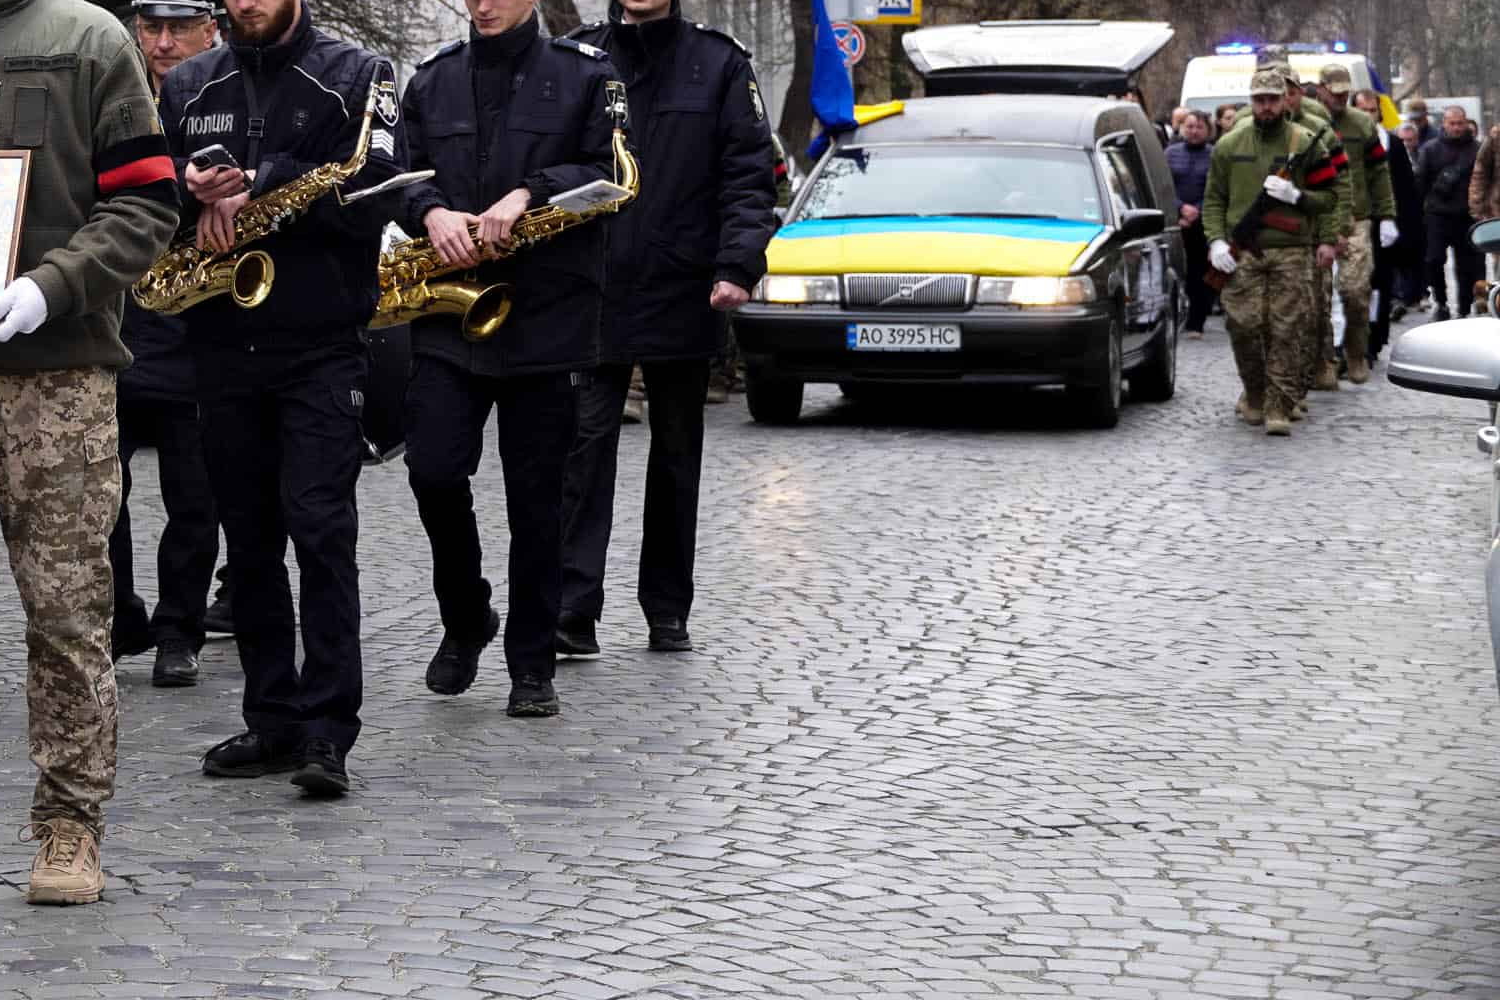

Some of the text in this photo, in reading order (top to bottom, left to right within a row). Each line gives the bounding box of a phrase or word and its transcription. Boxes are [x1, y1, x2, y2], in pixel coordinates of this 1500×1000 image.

[860, 327, 955, 344] AO 3995 HC
